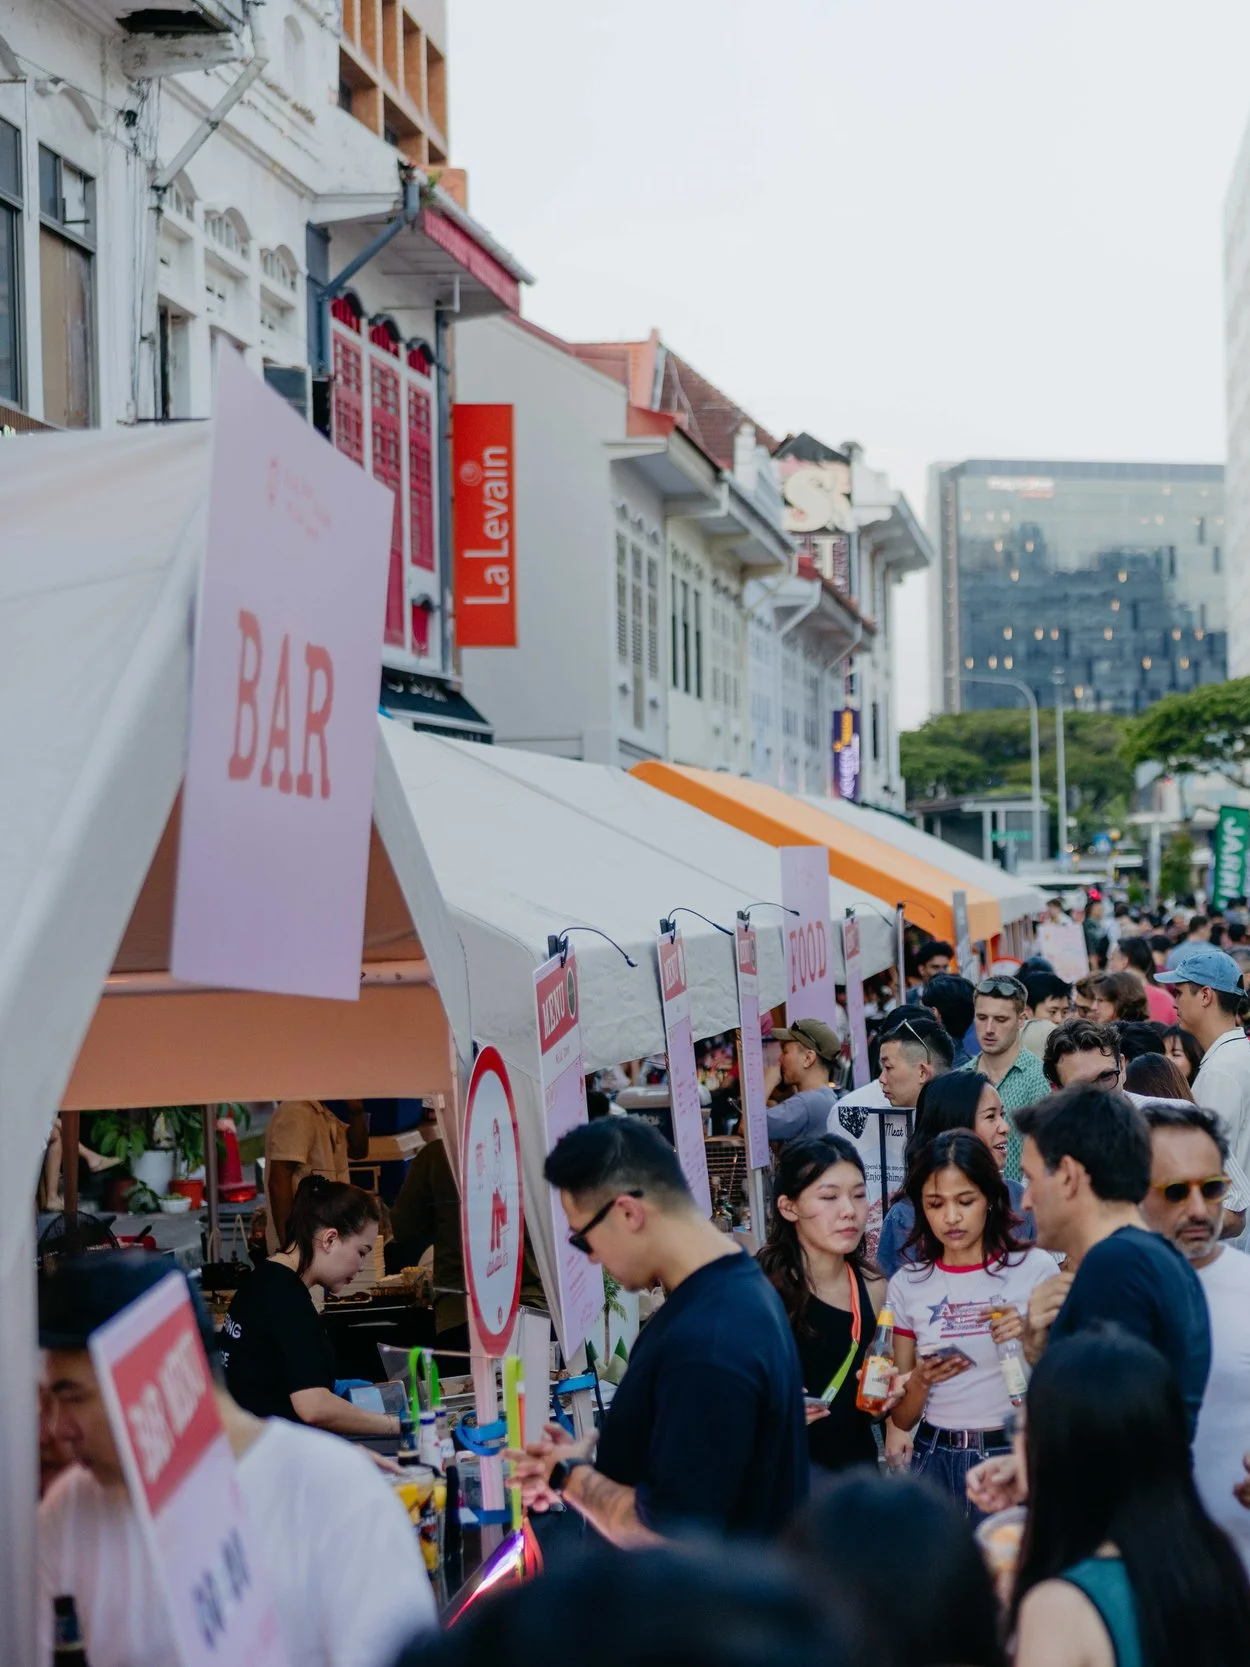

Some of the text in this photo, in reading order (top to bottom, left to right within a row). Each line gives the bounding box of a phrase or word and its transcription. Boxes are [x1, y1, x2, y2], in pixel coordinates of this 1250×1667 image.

[462, 446, 510, 604] La Levain
[227, 607, 336, 800] BAR
[541, 981, 566, 1041] MENU
[789, 919, 828, 994] FOOD
